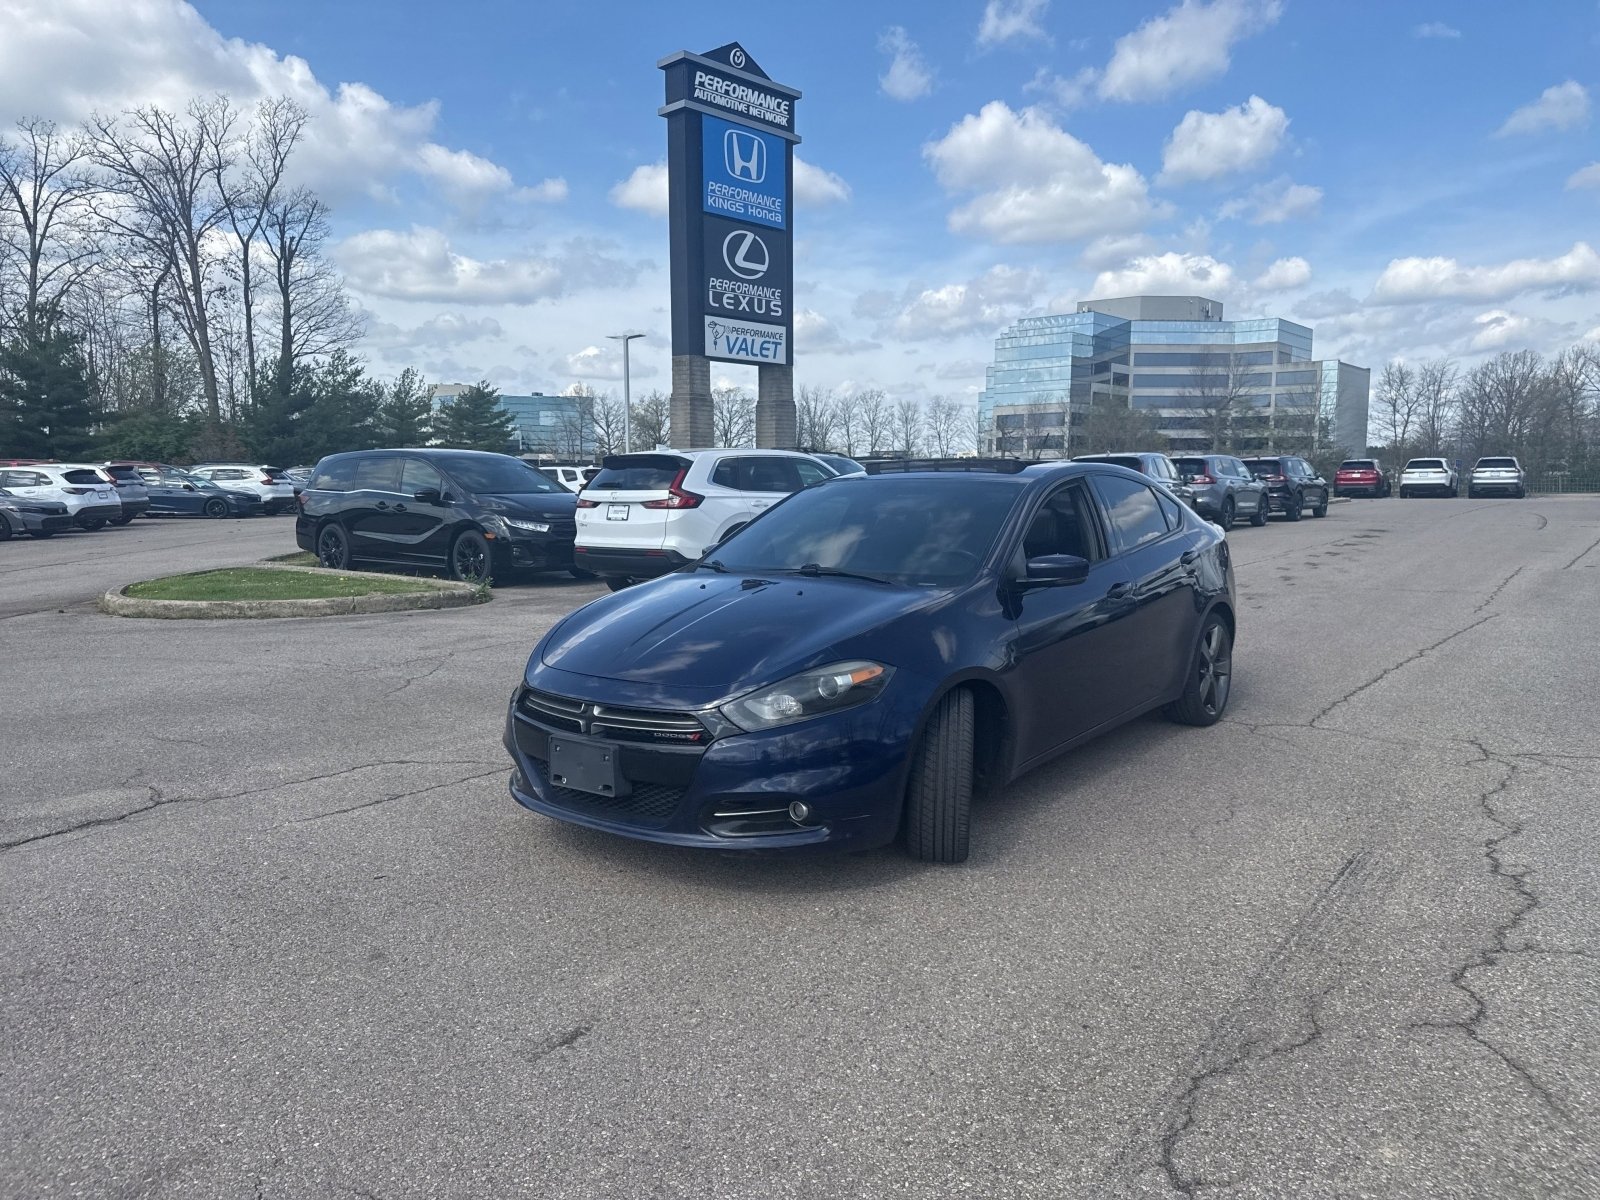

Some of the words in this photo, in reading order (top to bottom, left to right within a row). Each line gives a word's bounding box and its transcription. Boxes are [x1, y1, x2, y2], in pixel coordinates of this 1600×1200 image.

[694, 71, 790, 115] PERFORMANCE
[694, 88, 748, 114] AUTOMOTIVE
[749, 106, 788, 127] NETWORK
[707, 181, 782, 210] PERFORMANCE
[707, 195, 744, 213] KINGS
[709, 277, 782, 300] PERFORMANCE
[708, 290, 782, 316] LEXUS
[731, 326, 783, 341] PERFORMANCE
[725, 335, 783, 360] VALET
